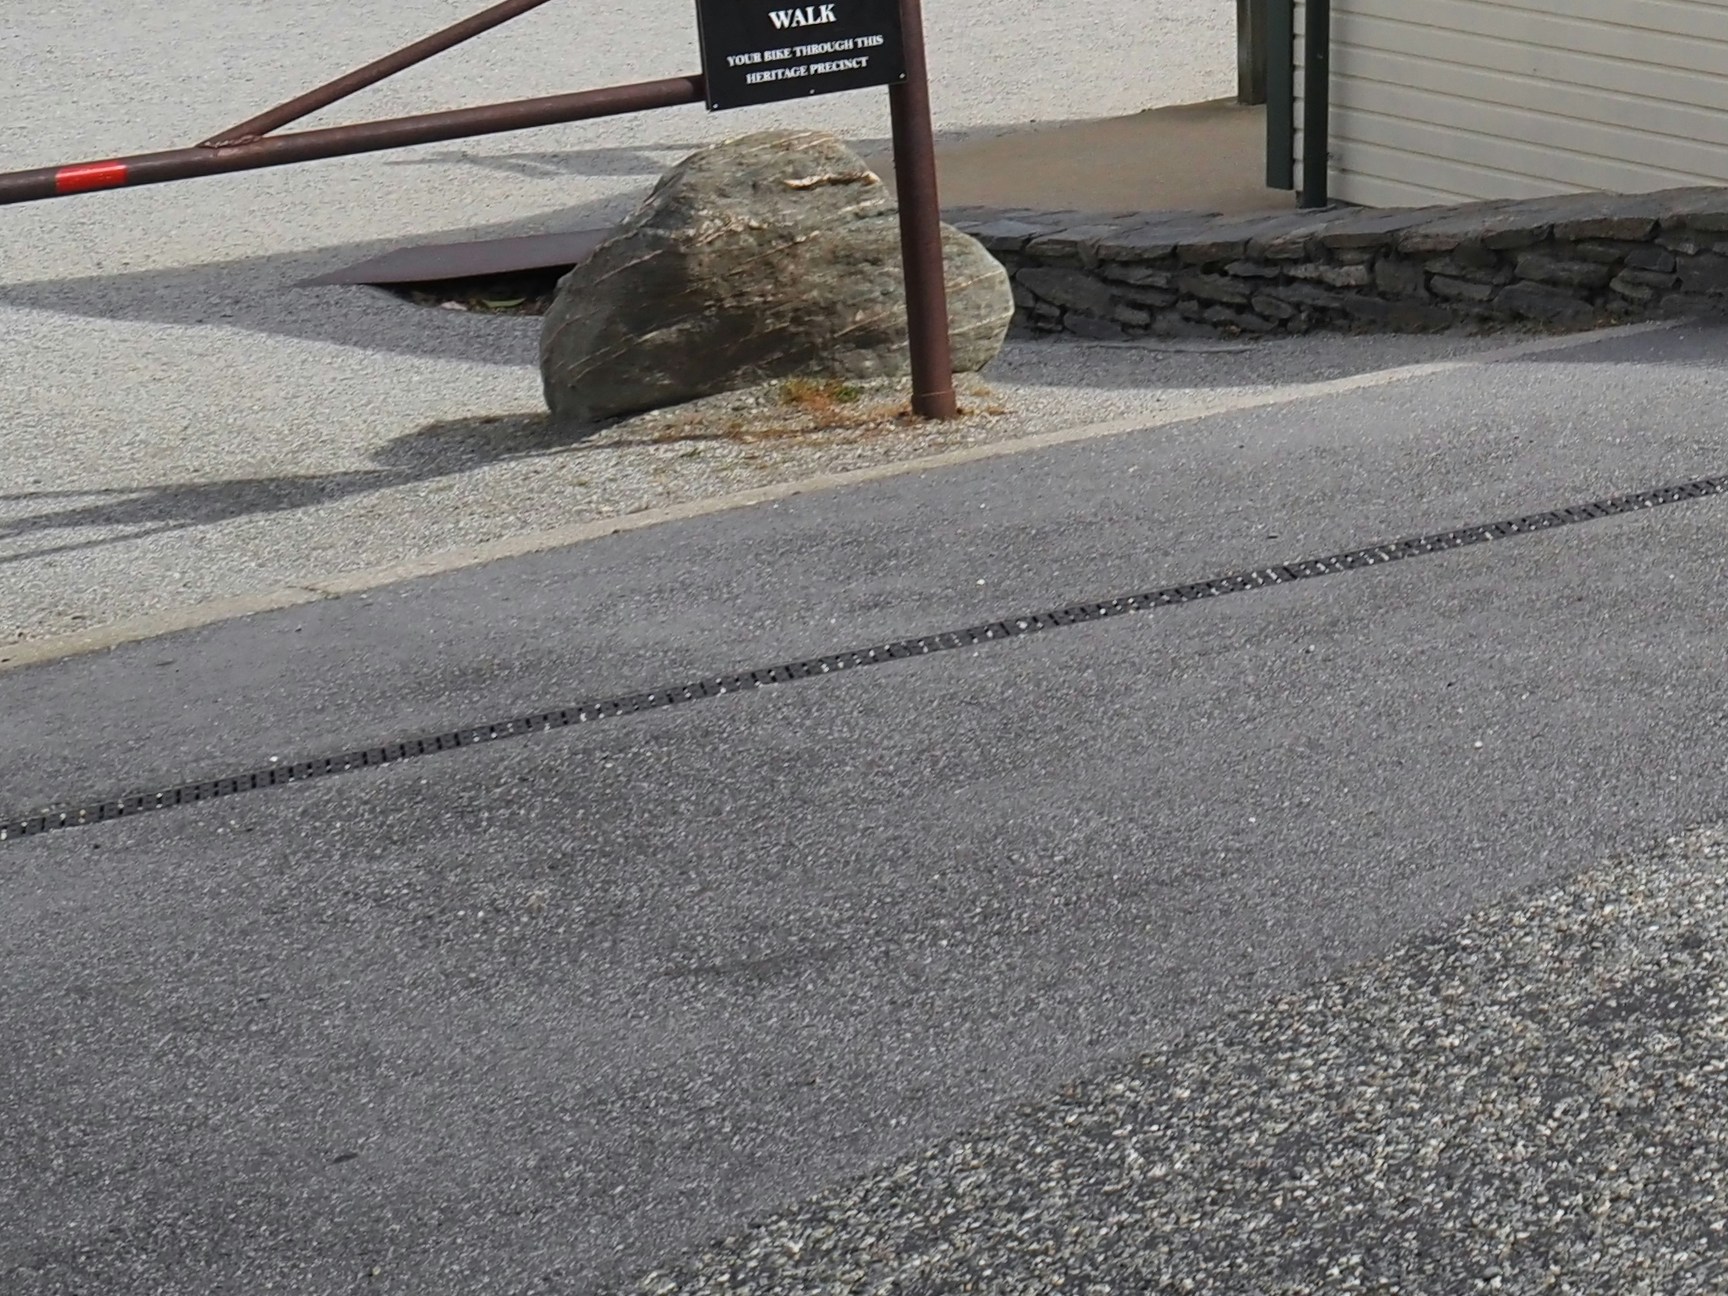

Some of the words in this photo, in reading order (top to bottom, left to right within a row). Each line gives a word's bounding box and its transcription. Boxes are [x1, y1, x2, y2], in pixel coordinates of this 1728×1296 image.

[768, 4, 836, 30] WALK
[726, 52, 762, 67] YOUR
[764, 47, 792, 62] BIKE
[793, 39, 853, 58] THROUGH
[854, 34, 884, 48] THIS
[746, 65, 808, 85] HERITAGE
[810, 56, 869, 75] PRECINCT
